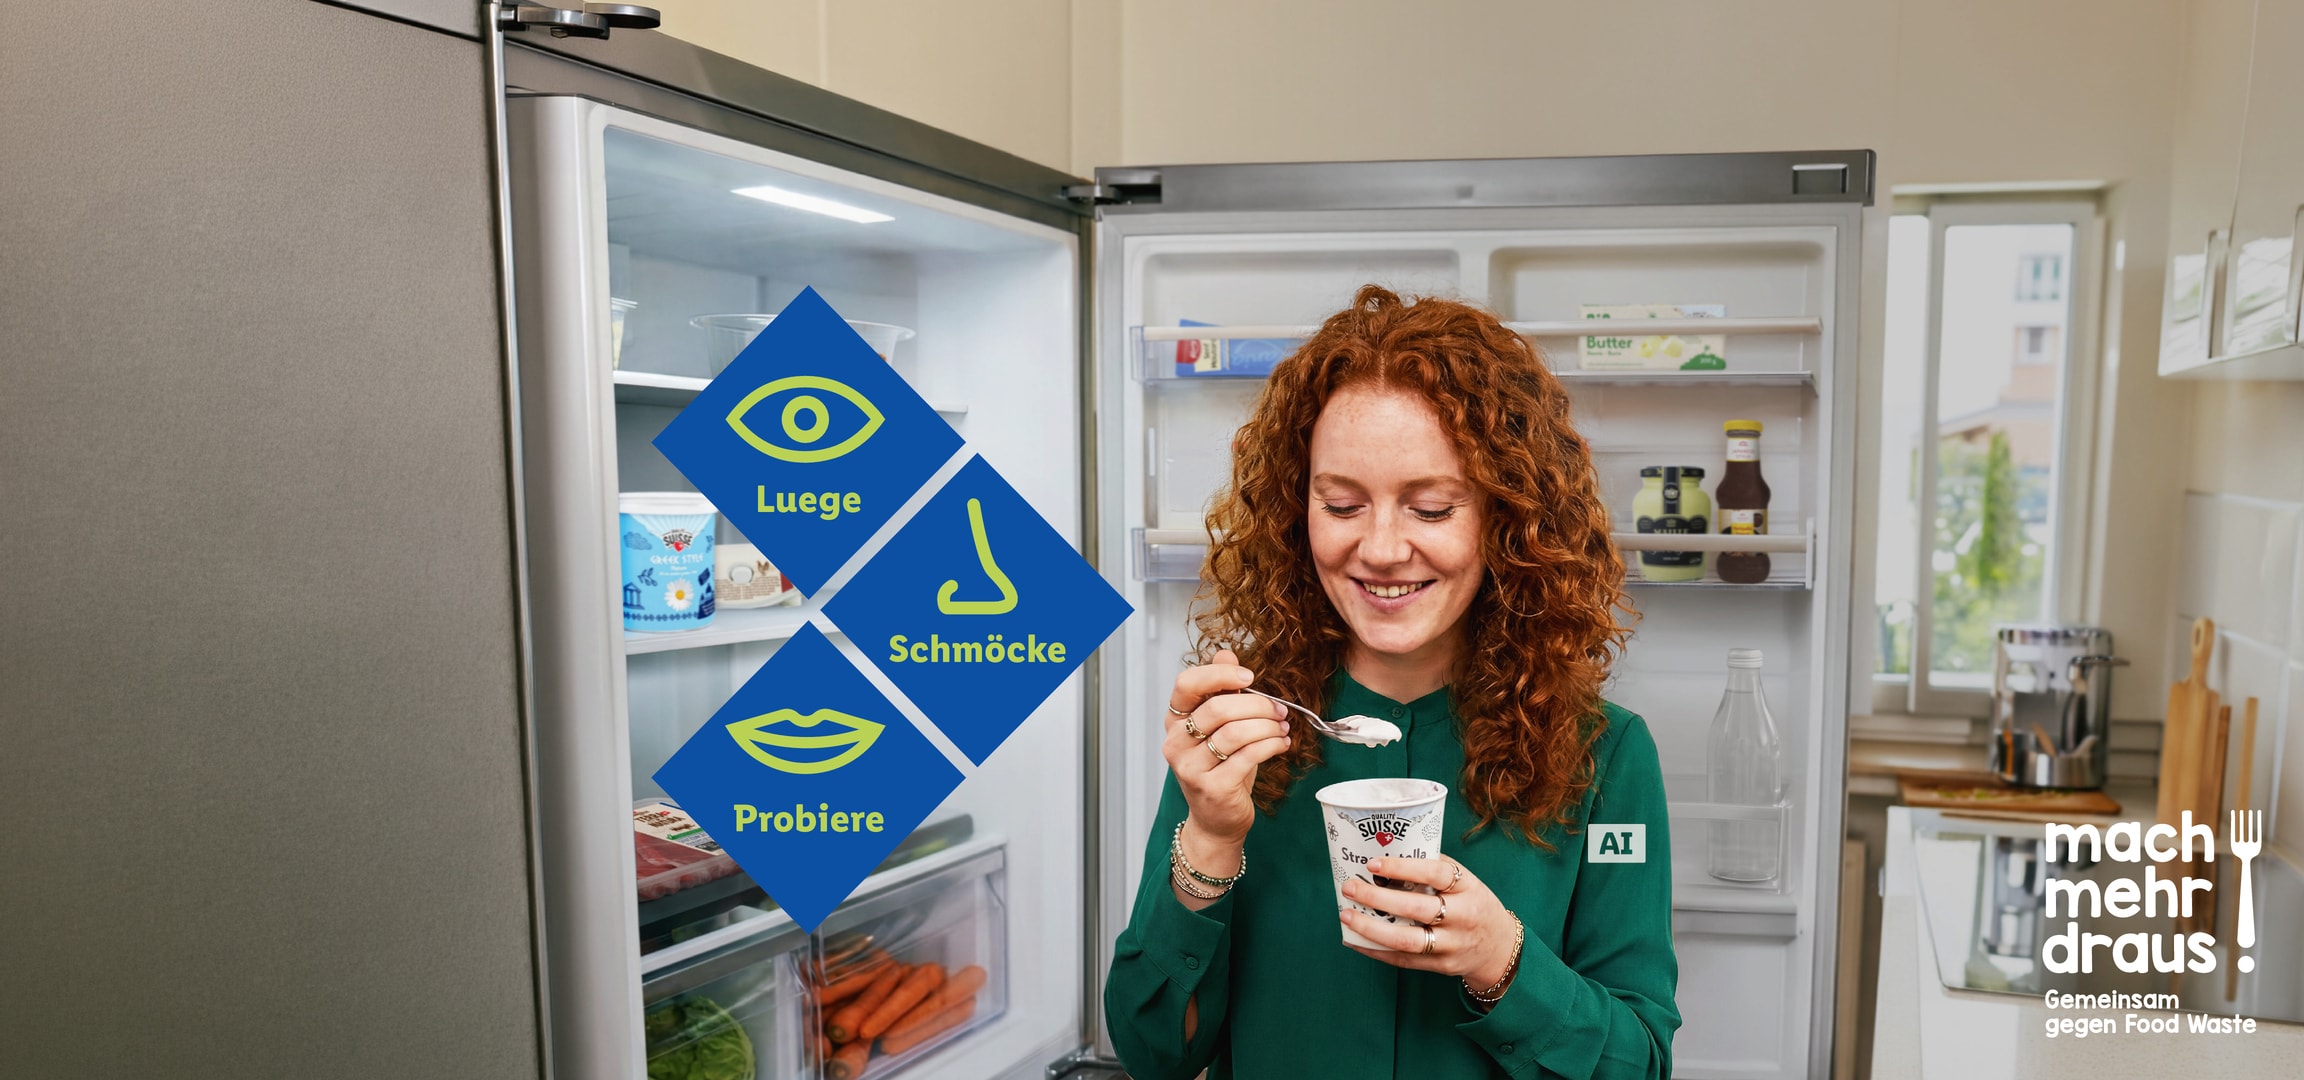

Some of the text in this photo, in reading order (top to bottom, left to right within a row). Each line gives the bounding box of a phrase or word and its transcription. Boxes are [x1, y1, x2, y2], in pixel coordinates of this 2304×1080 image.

[1586, 336, 1633, 349] Butter
[663, 533, 693, 546] SUISSE
[1371, 812, 1396, 820] QUALITÉ
[1358, 820, 1410, 838] SUISSE
